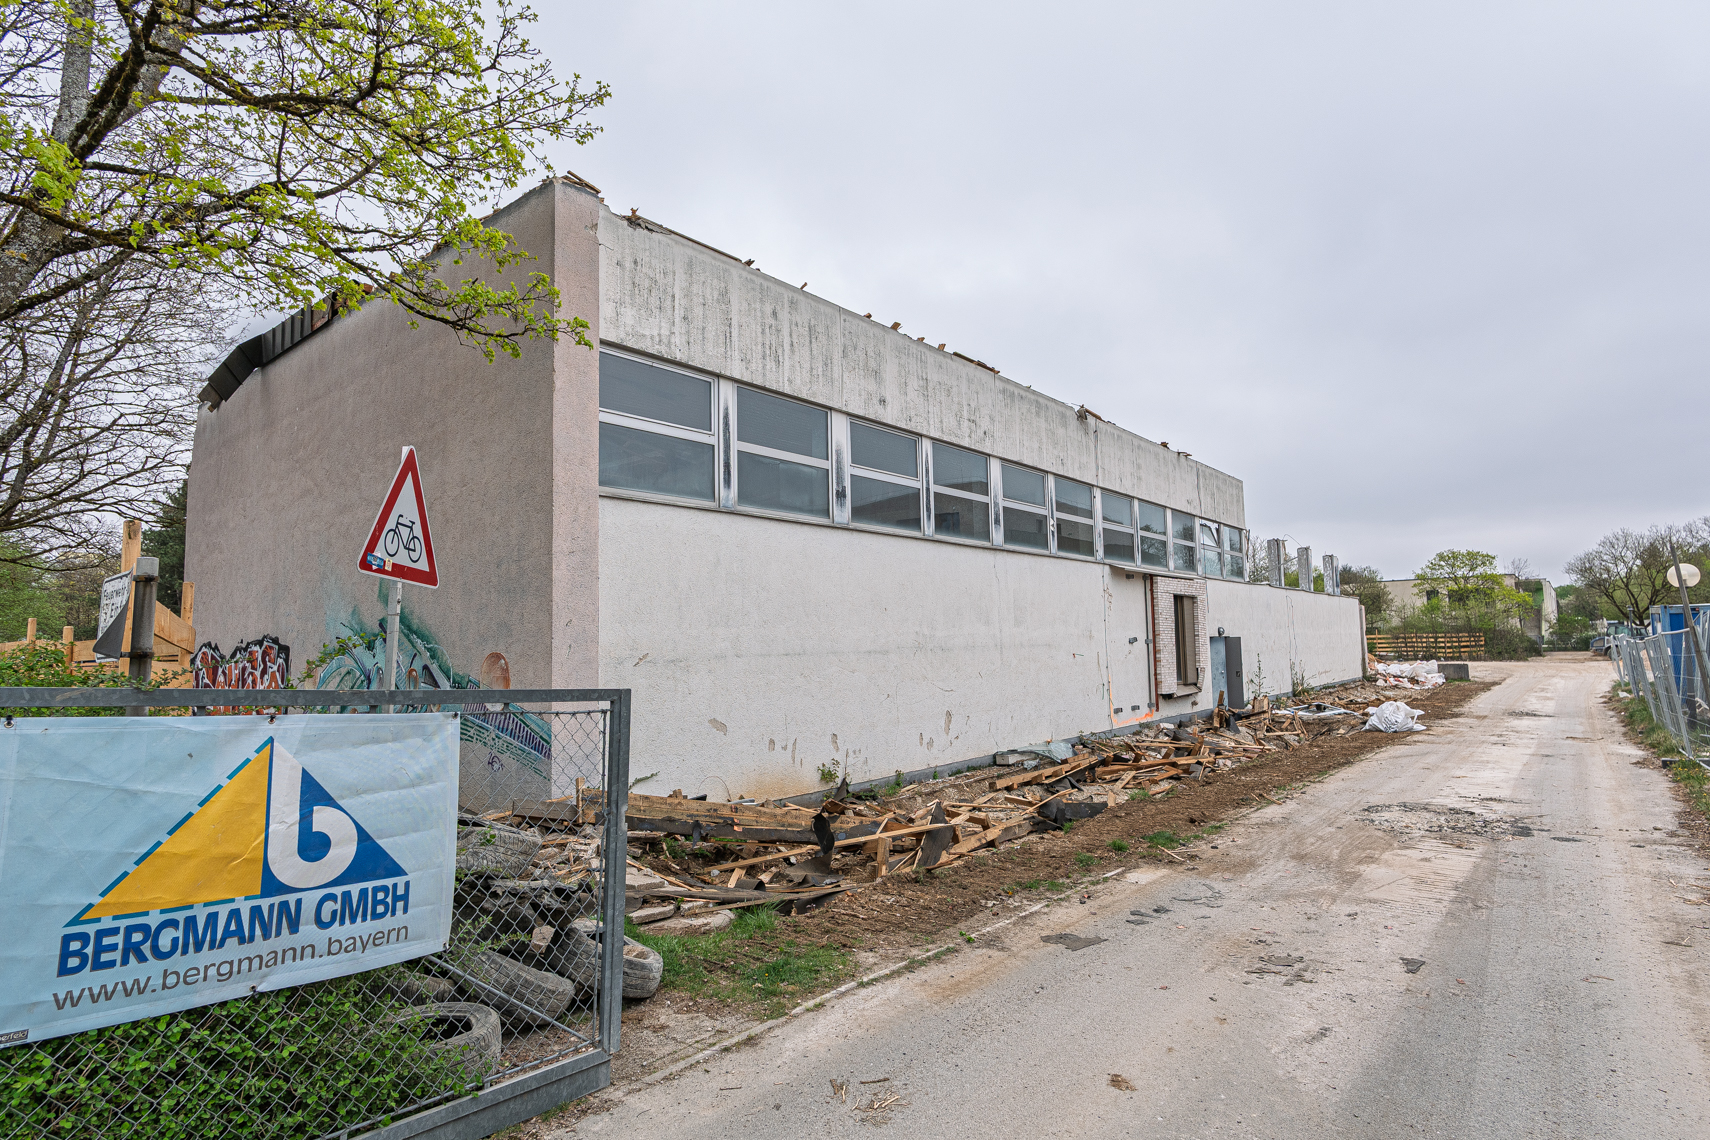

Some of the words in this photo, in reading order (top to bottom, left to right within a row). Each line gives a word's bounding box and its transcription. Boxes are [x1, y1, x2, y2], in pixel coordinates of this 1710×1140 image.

[52, 925, 409, 1011] www.bergmann.bayern
[56, 897, 303, 978] BERGMANN
[313, 880, 411, 931] GMBH
